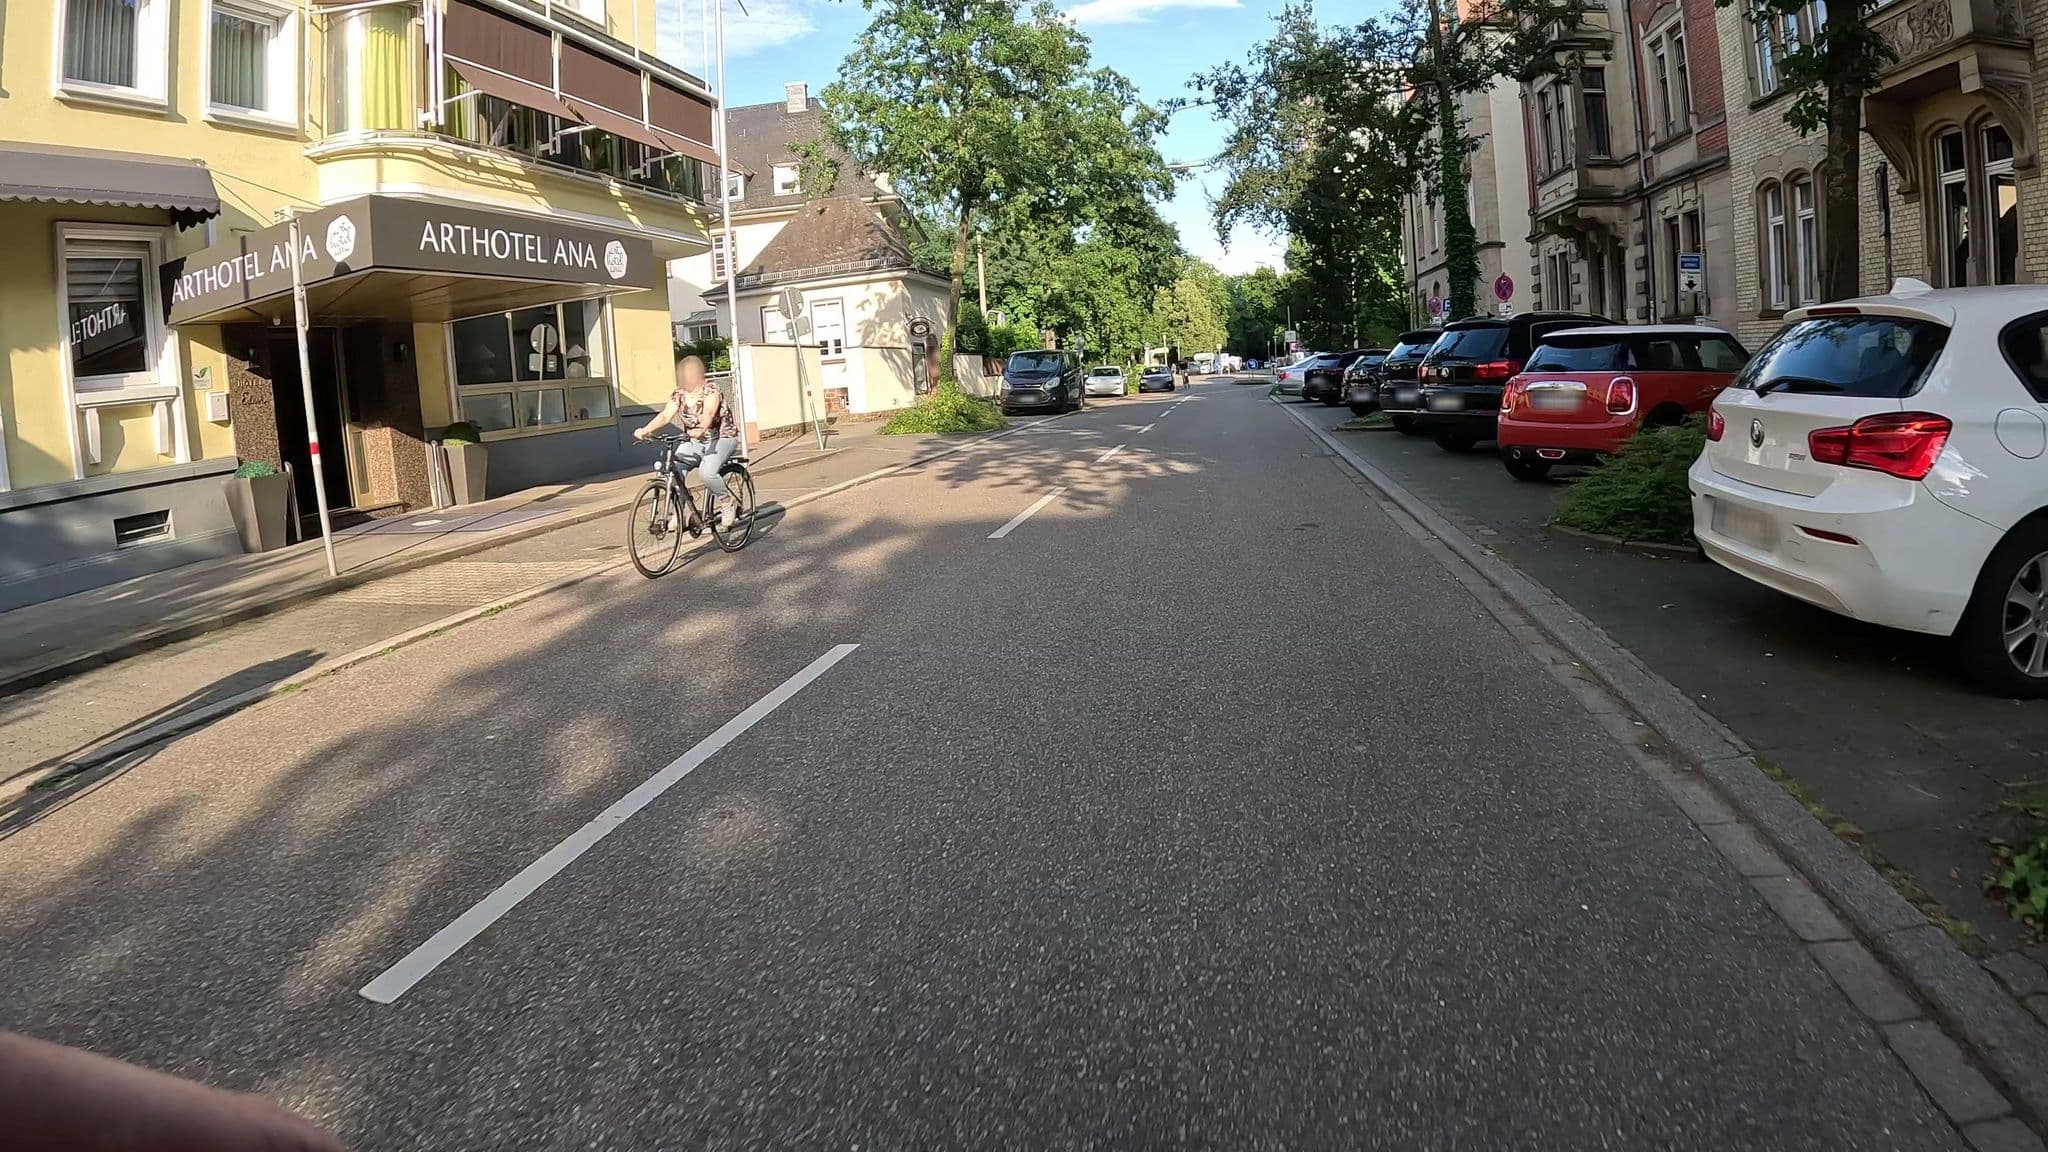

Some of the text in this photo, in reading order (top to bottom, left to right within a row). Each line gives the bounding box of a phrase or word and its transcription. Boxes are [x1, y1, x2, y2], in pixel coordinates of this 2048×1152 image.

[420, 221, 547, 263] ARTHOTEL
[554, 239, 597, 270] ANA
[172, 252, 265, 303] ARTHOTEL
